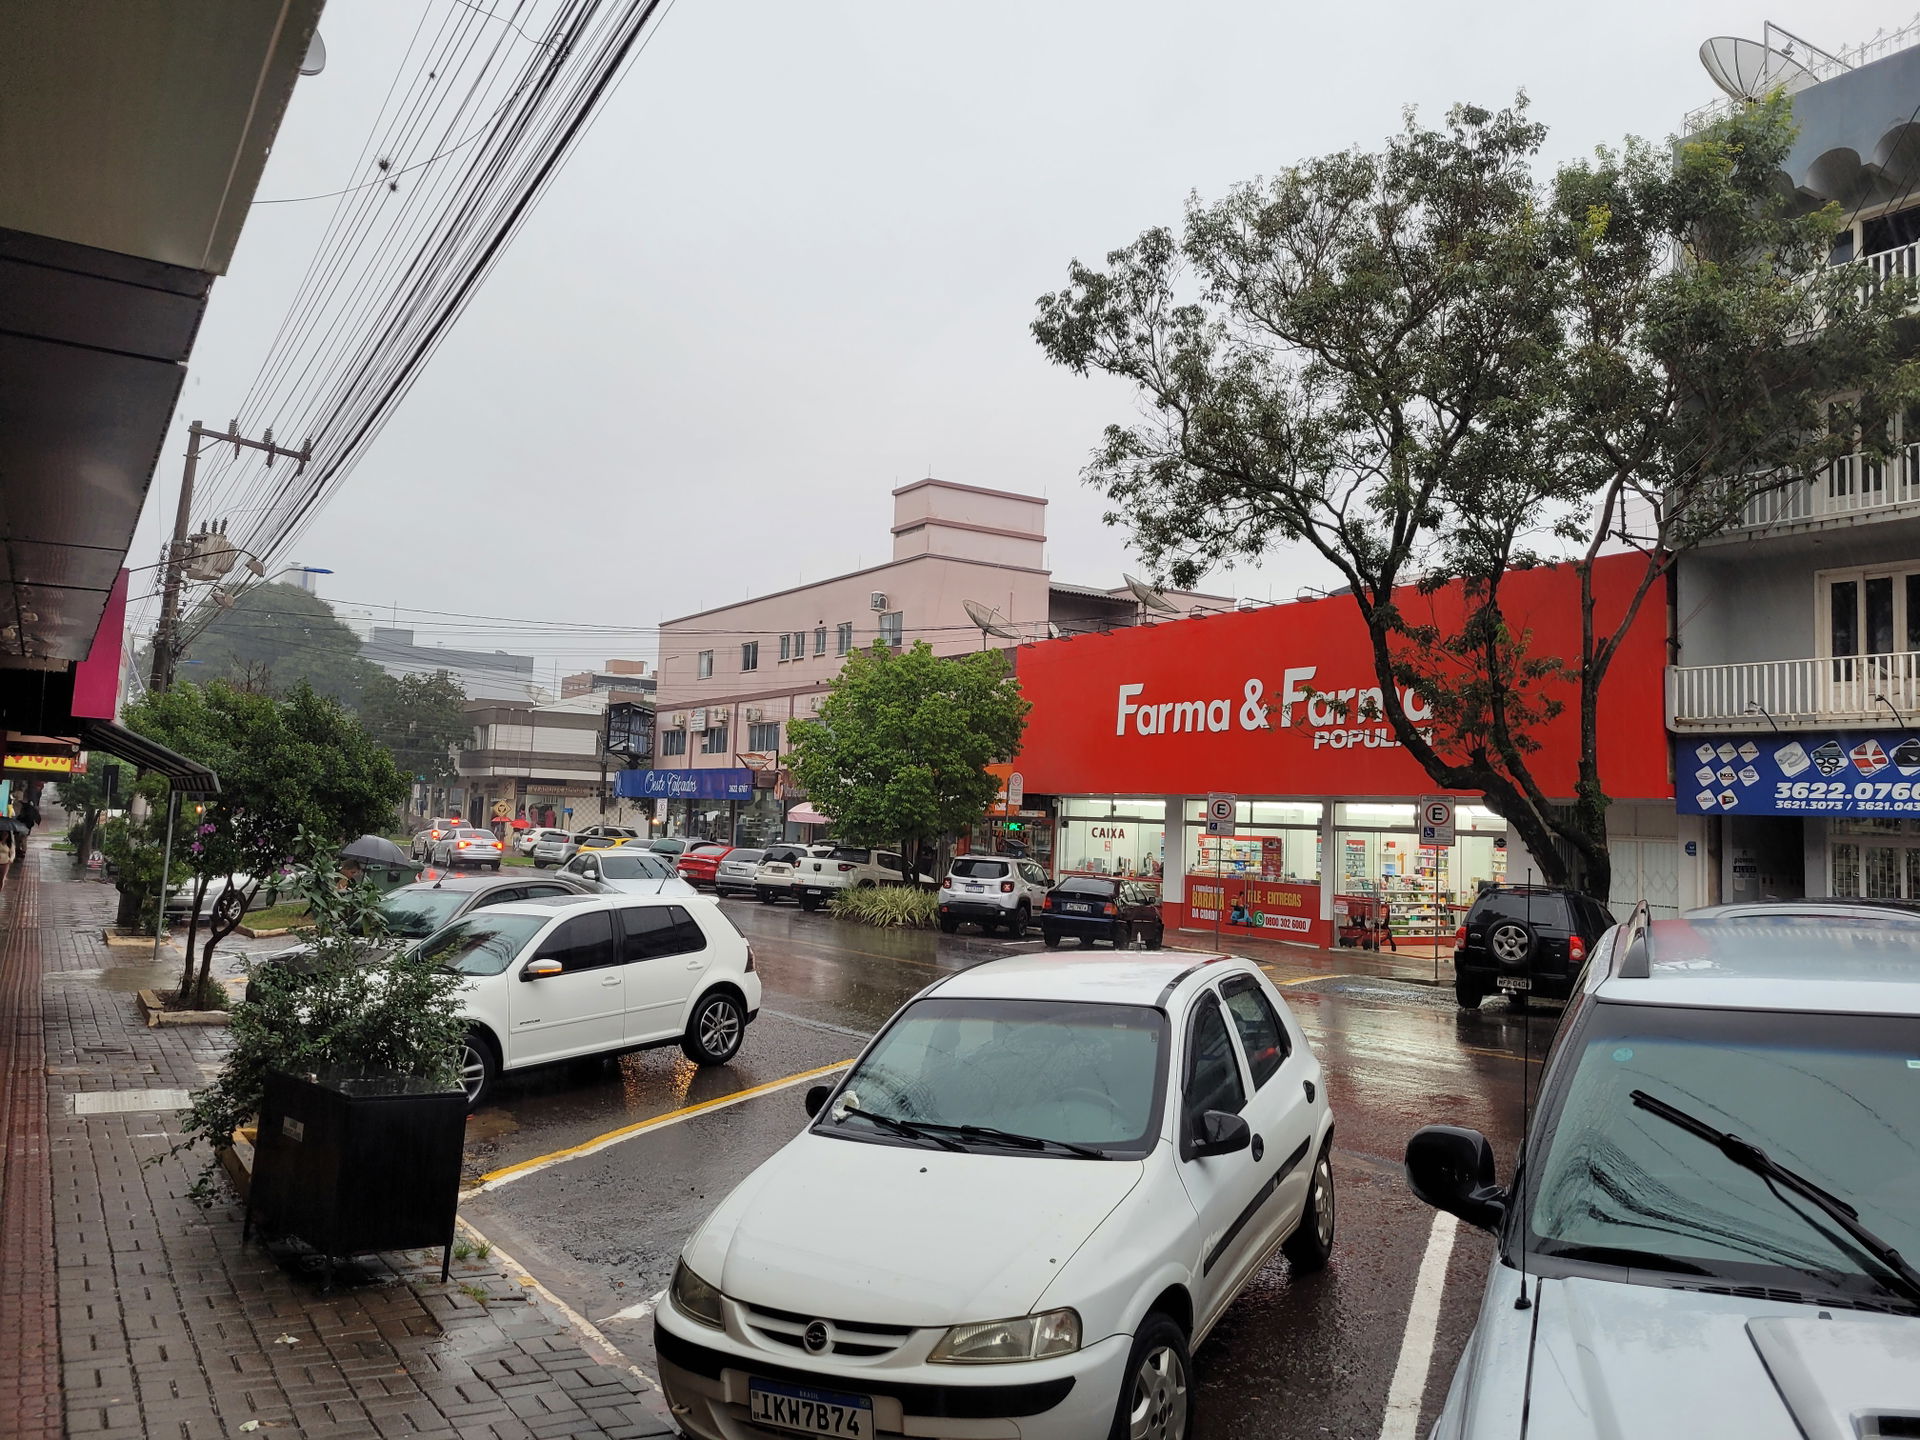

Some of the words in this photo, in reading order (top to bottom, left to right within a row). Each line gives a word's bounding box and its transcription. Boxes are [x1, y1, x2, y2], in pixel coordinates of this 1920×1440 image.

[1116, 683, 1231, 736] Farma
[1239, 678, 1270, 731] &
[1314, 727, 1433, 750] POPULR
[1216, 803, 1226, 816] E
[1775, 800, 1843, 811] 3621.3073
[1846, 801, 1853, 811] /
[1432, 807, 1443, 821] E
[1091, 827, 1125, 839] CAIXA
[1192, 892, 1224, 910] BARATA
[1267, 891, 1302, 908] ENTREGAS
[1265, 916, 1279, 927] 0800
[1280, 918, 1291, 928] 302
[1291, 919, 1307, 930] 6000
[799, 1390, 819, 1400] BRASIL
[761, 1393, 859, 1436] IKW7B74
